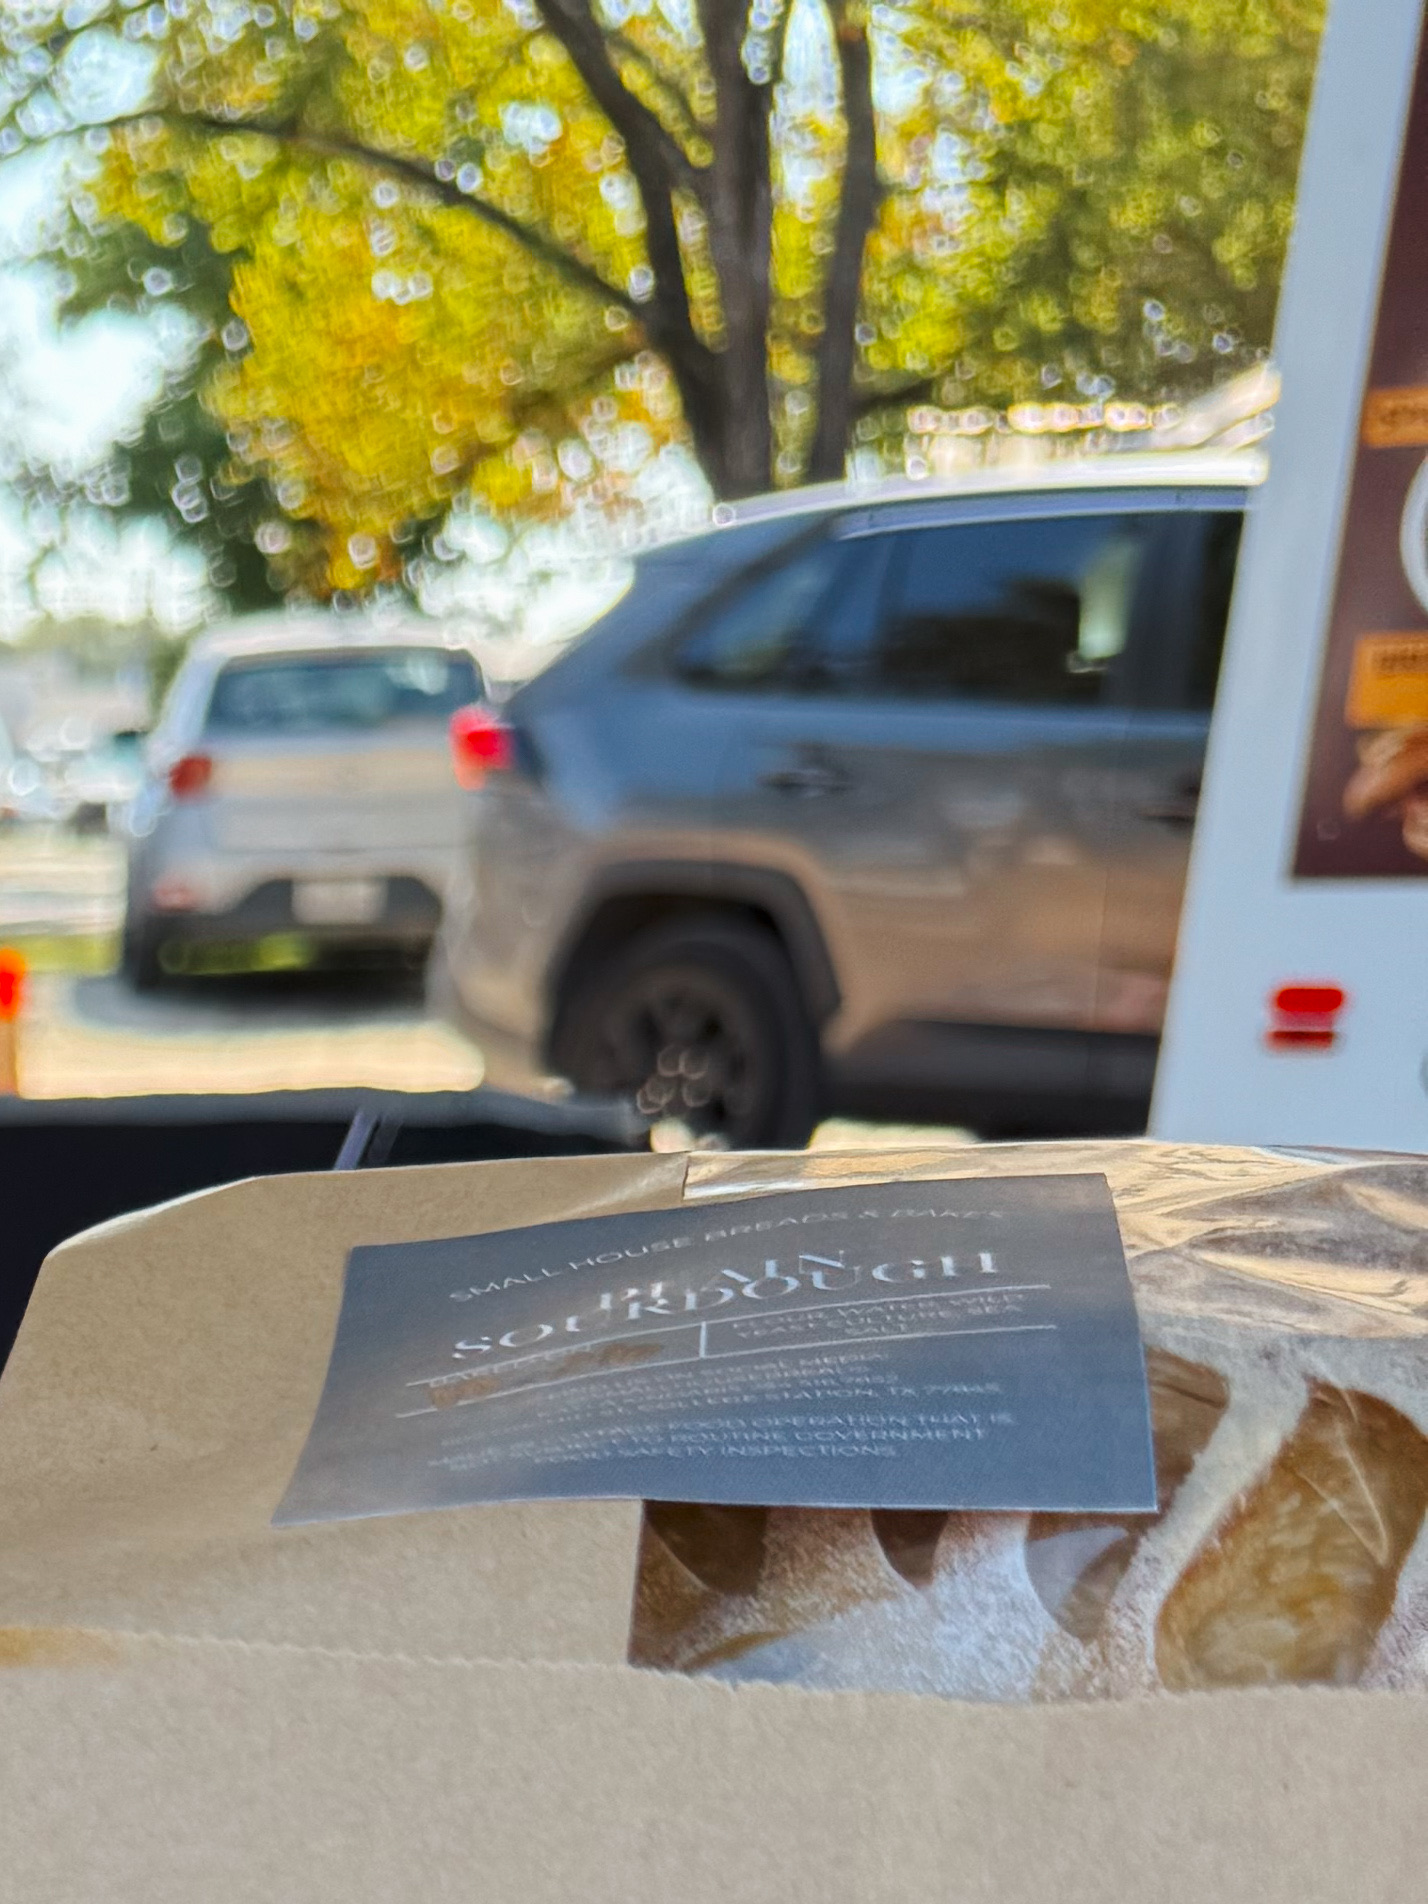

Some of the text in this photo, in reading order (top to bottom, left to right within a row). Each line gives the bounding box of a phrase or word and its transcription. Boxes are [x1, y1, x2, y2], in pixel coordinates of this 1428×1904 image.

[450, 1268, 563, 1302] SMALL
[569, 1237, 692, 1271] HOUSE
[453, 1251, 998, 1359] SOURDOUGH
